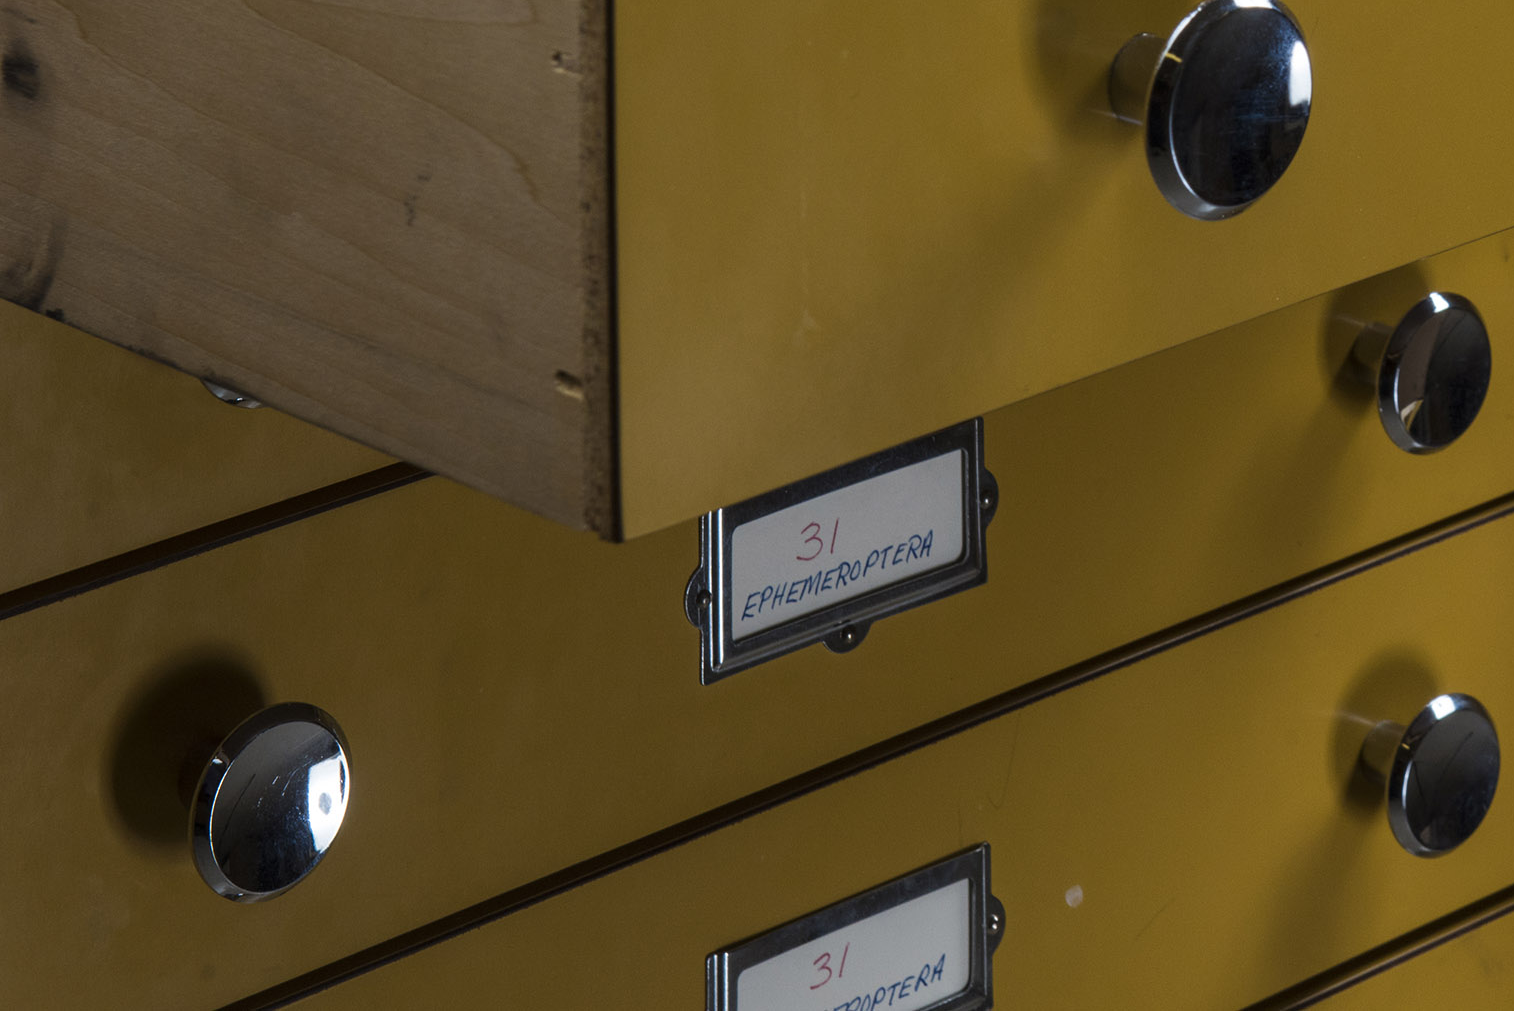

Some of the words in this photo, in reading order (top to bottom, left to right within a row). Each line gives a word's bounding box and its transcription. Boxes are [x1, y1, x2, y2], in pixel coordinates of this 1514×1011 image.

[796, 517, 840, 561] 31
[741, 529, 934, 622] EPHEMEROPTERA
[810, 942, 850, 990] 31
